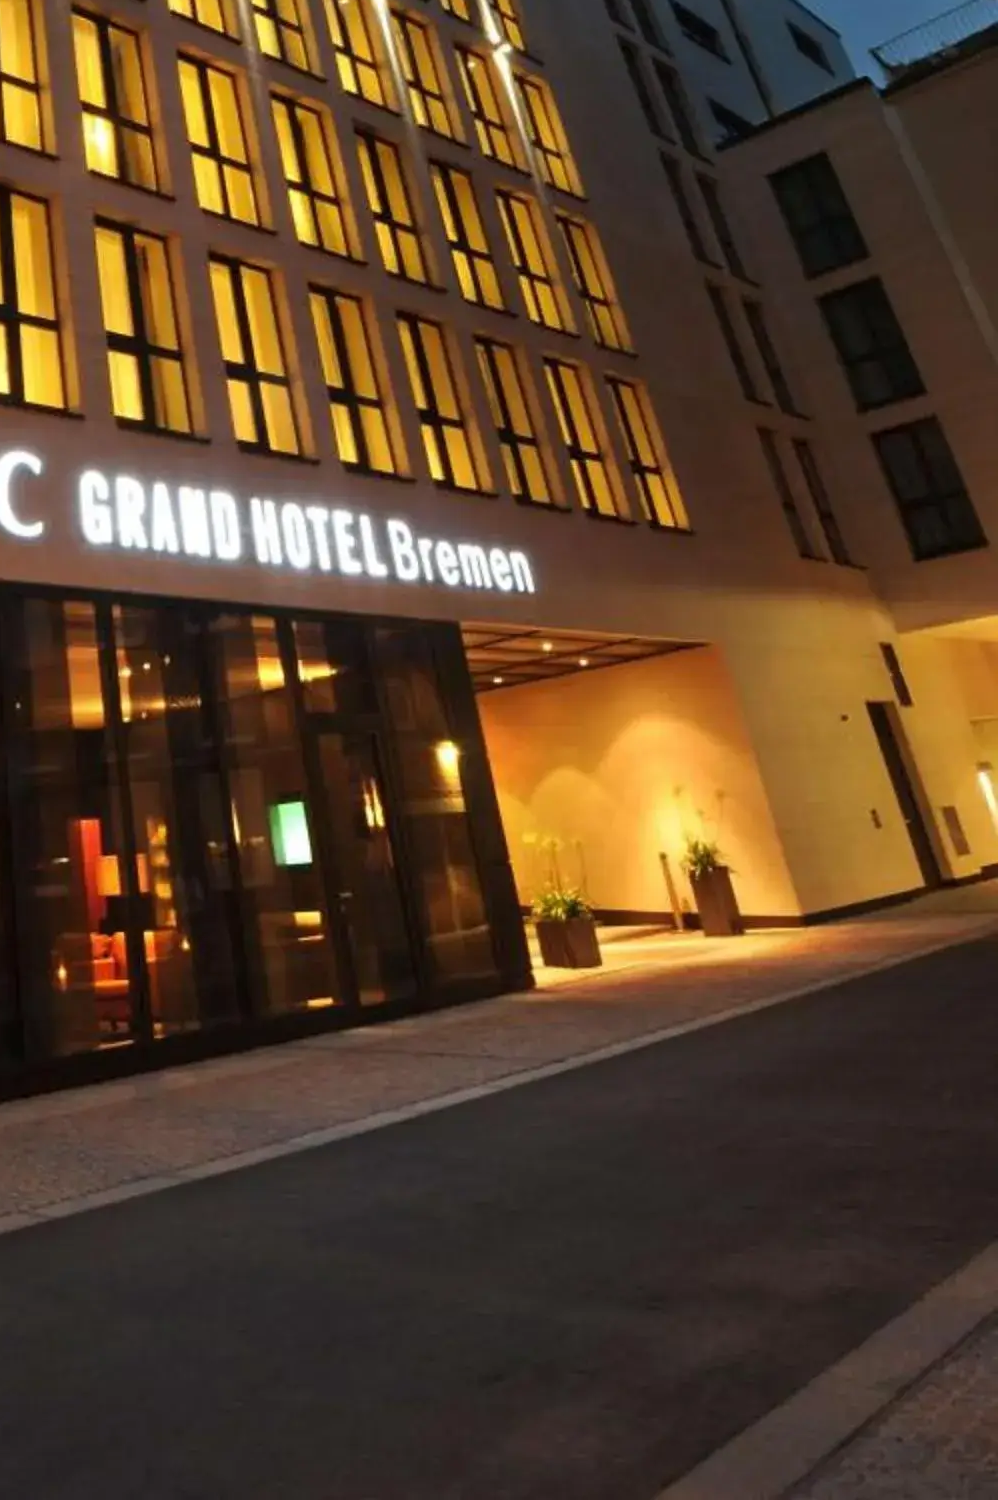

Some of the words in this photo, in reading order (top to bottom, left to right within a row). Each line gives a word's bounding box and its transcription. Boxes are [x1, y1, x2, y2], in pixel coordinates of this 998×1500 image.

[77, 468, 243, 562] GRAND
[248, 496, 390, 579] HOTEL
[385, 518, 536, 594] Bremen
